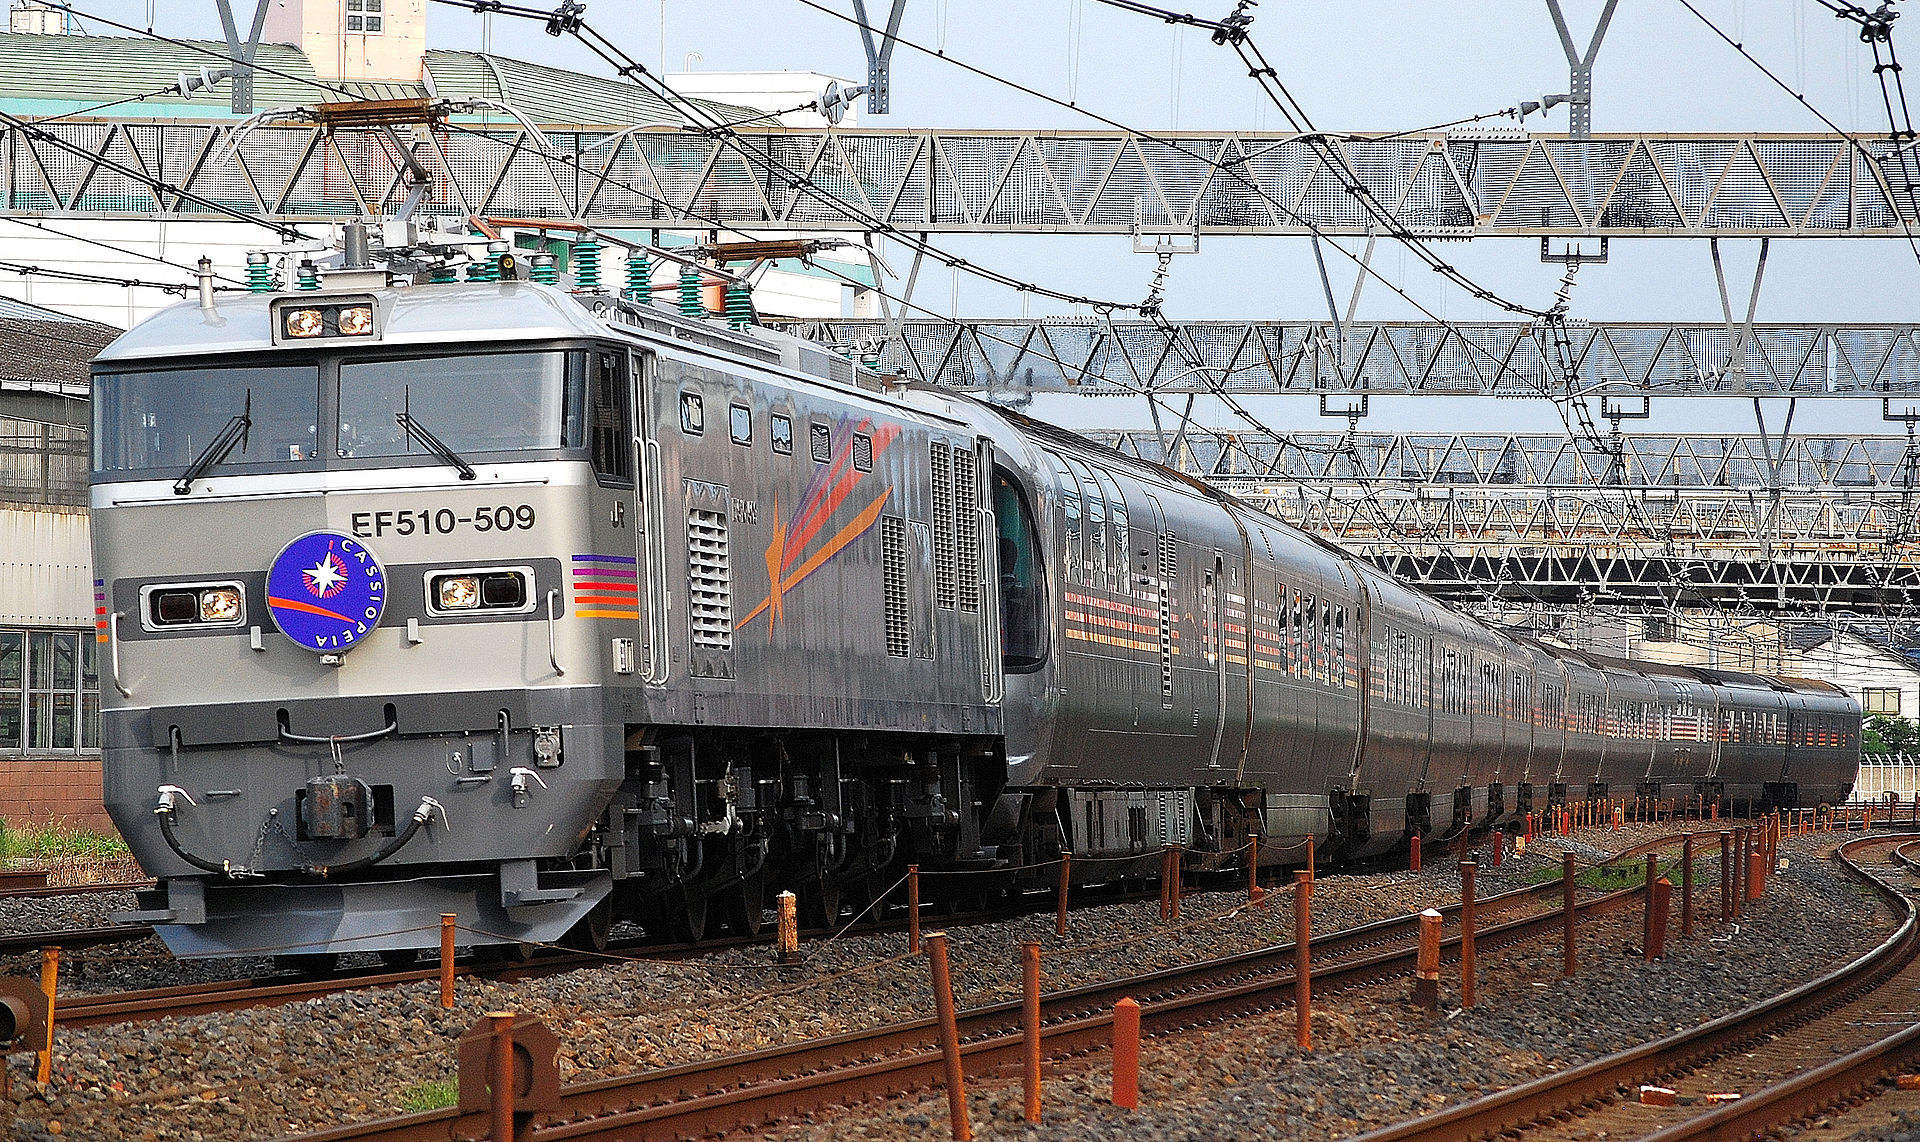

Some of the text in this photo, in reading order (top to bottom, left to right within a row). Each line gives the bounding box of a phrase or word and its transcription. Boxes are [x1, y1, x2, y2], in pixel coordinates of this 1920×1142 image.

[352, 504, 535, 538] EF510-509
[611, 500, 625, 529] JR
[315, 538, 383, 648] CASSIOPEIA
